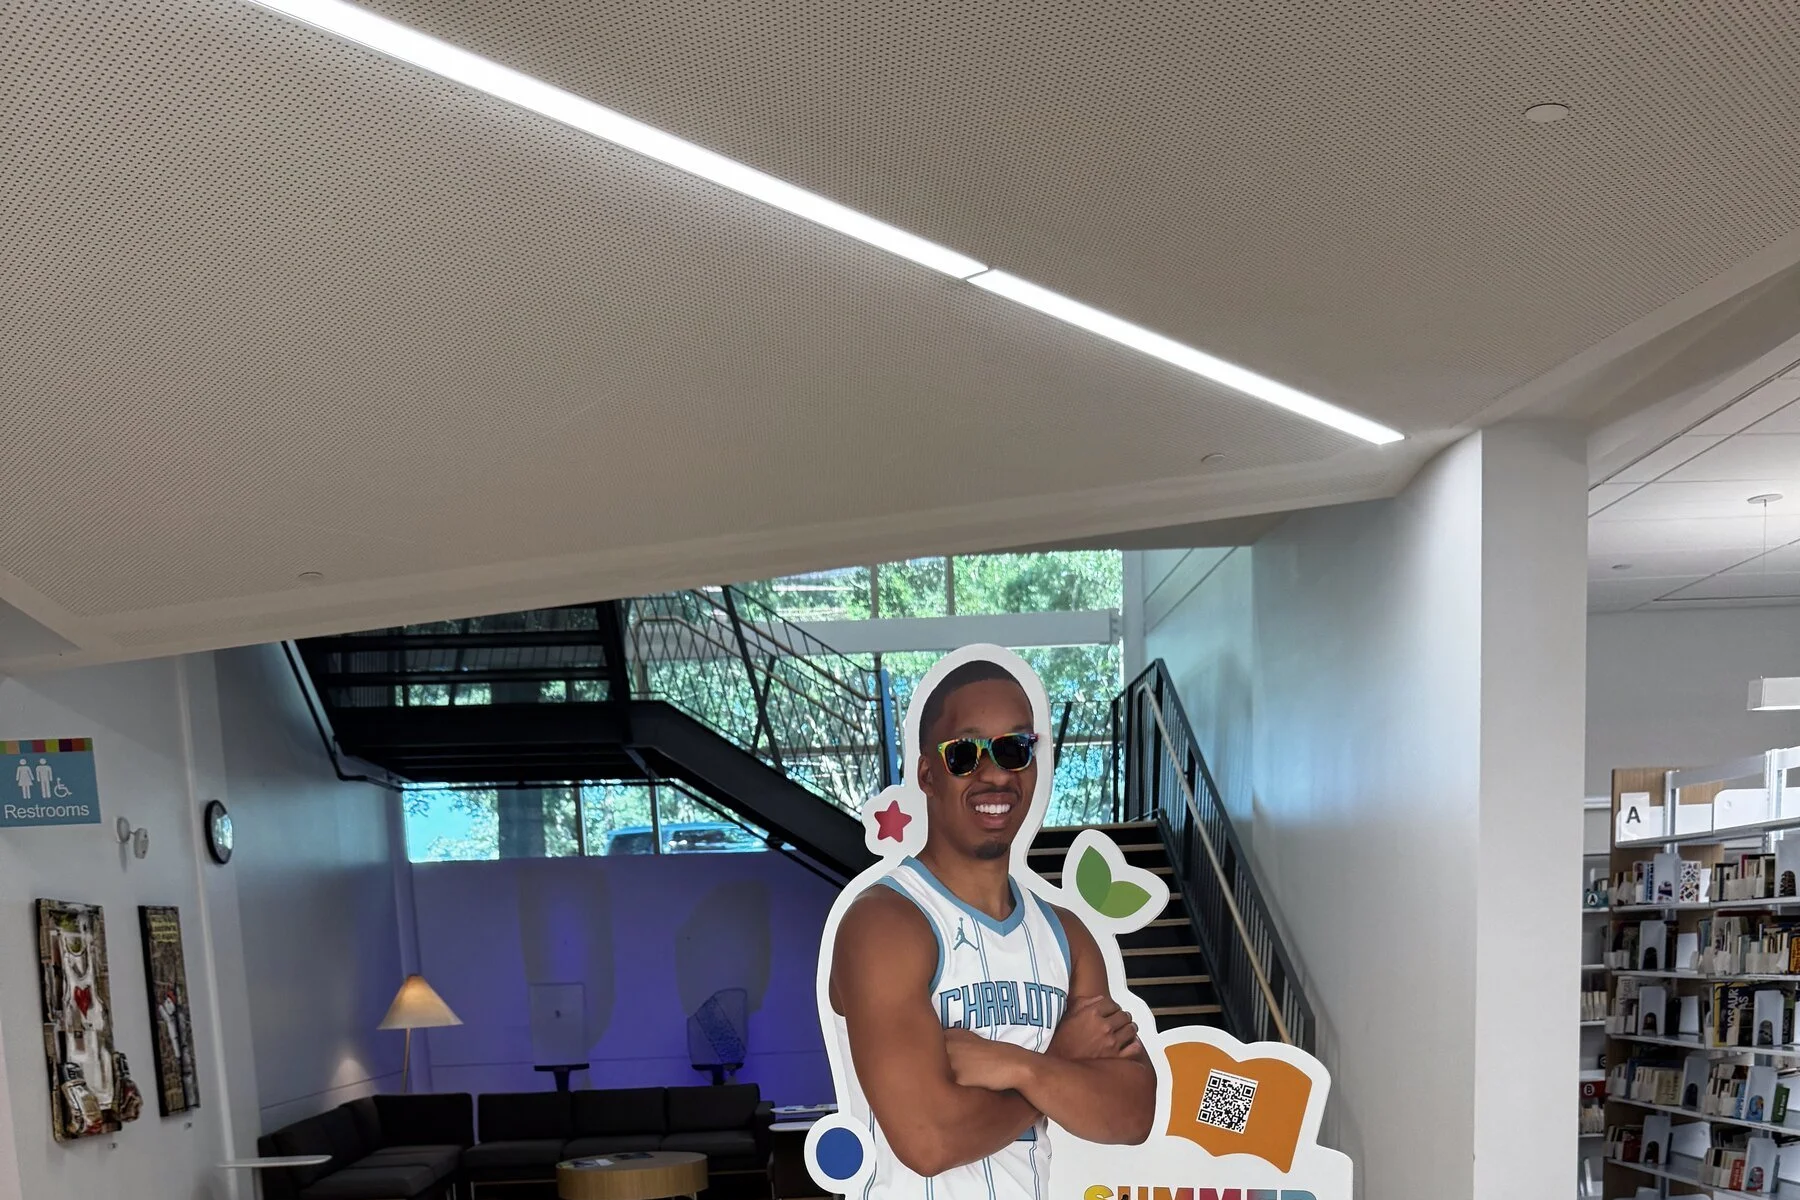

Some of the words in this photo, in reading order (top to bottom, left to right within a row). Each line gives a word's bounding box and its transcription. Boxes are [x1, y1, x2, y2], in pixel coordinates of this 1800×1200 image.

[4, 804, 89, 819] Restrooms
[1626, 806, 1641, 824] A
[938, 980, 1068, 1029] CHARLOTT
